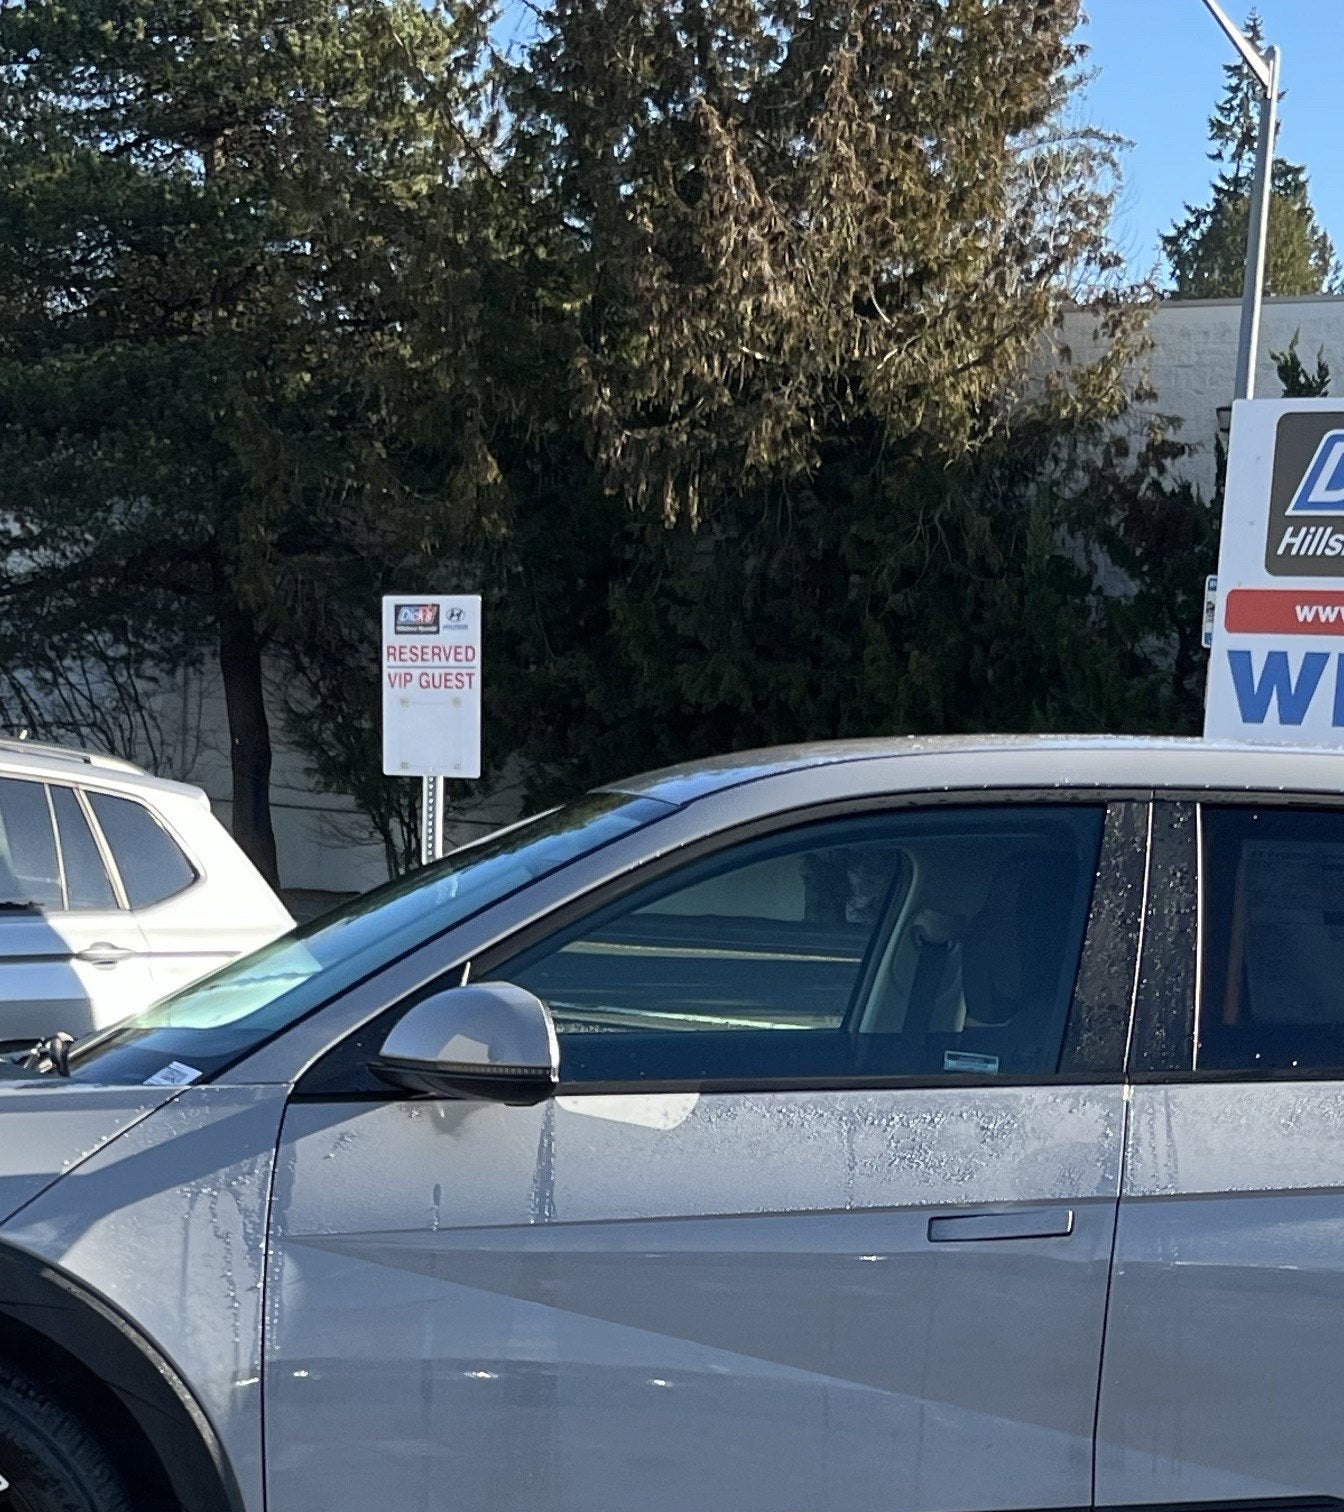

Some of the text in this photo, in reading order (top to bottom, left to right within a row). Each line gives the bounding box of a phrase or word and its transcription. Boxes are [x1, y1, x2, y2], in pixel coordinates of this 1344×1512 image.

[386, 645, 476, 662] RESERVED
[387, 672, 476, 690] VIP GUEST
